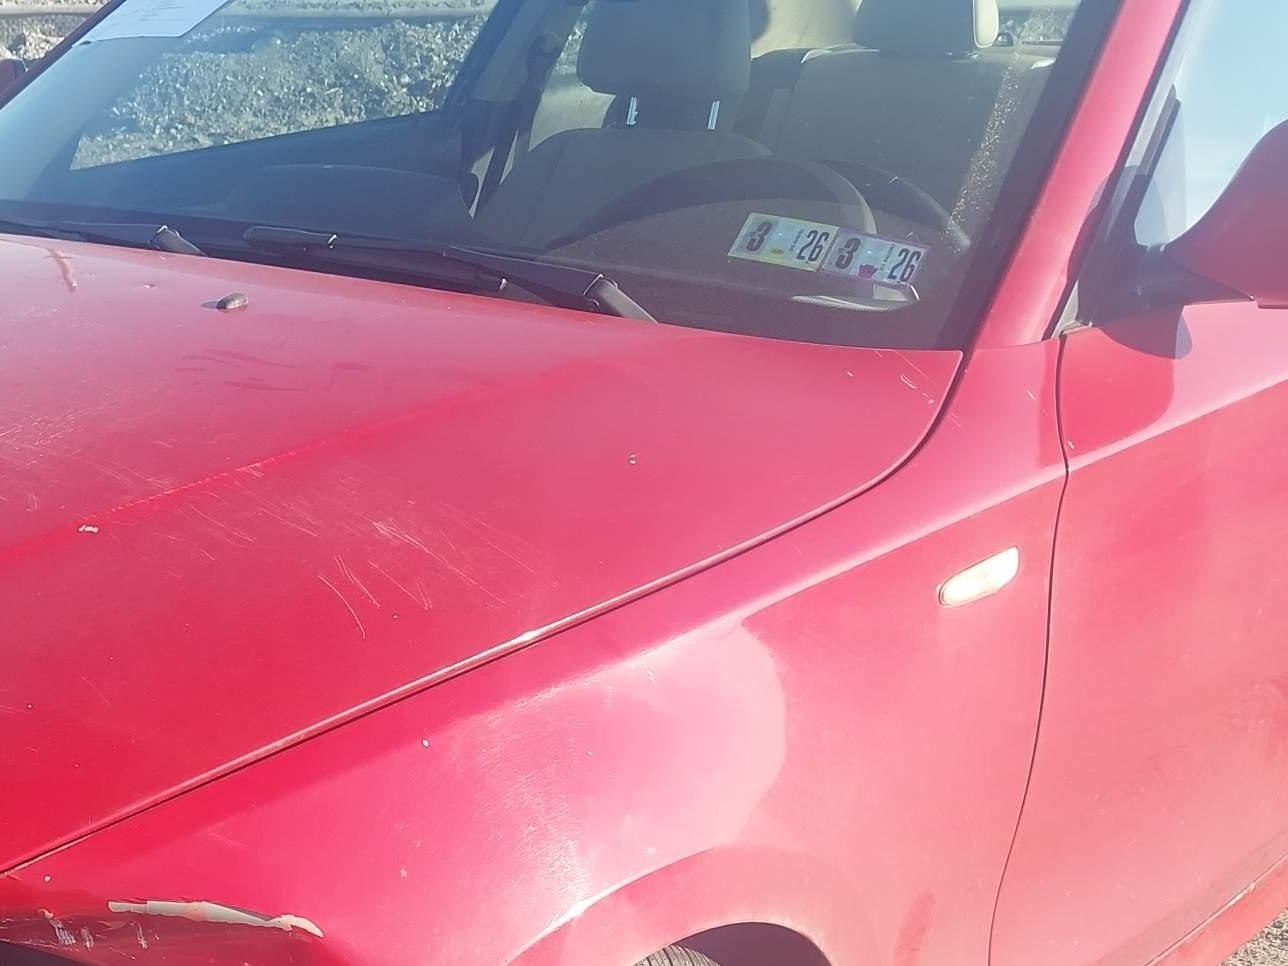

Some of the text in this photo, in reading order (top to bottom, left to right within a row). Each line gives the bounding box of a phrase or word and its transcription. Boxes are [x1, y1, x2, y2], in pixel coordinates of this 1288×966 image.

[746, 221, 772, 252] 3
[796, 229, 830, 262] 26
[836, 237, 861, 269] 3
[888, 248, 921, 282] 26
